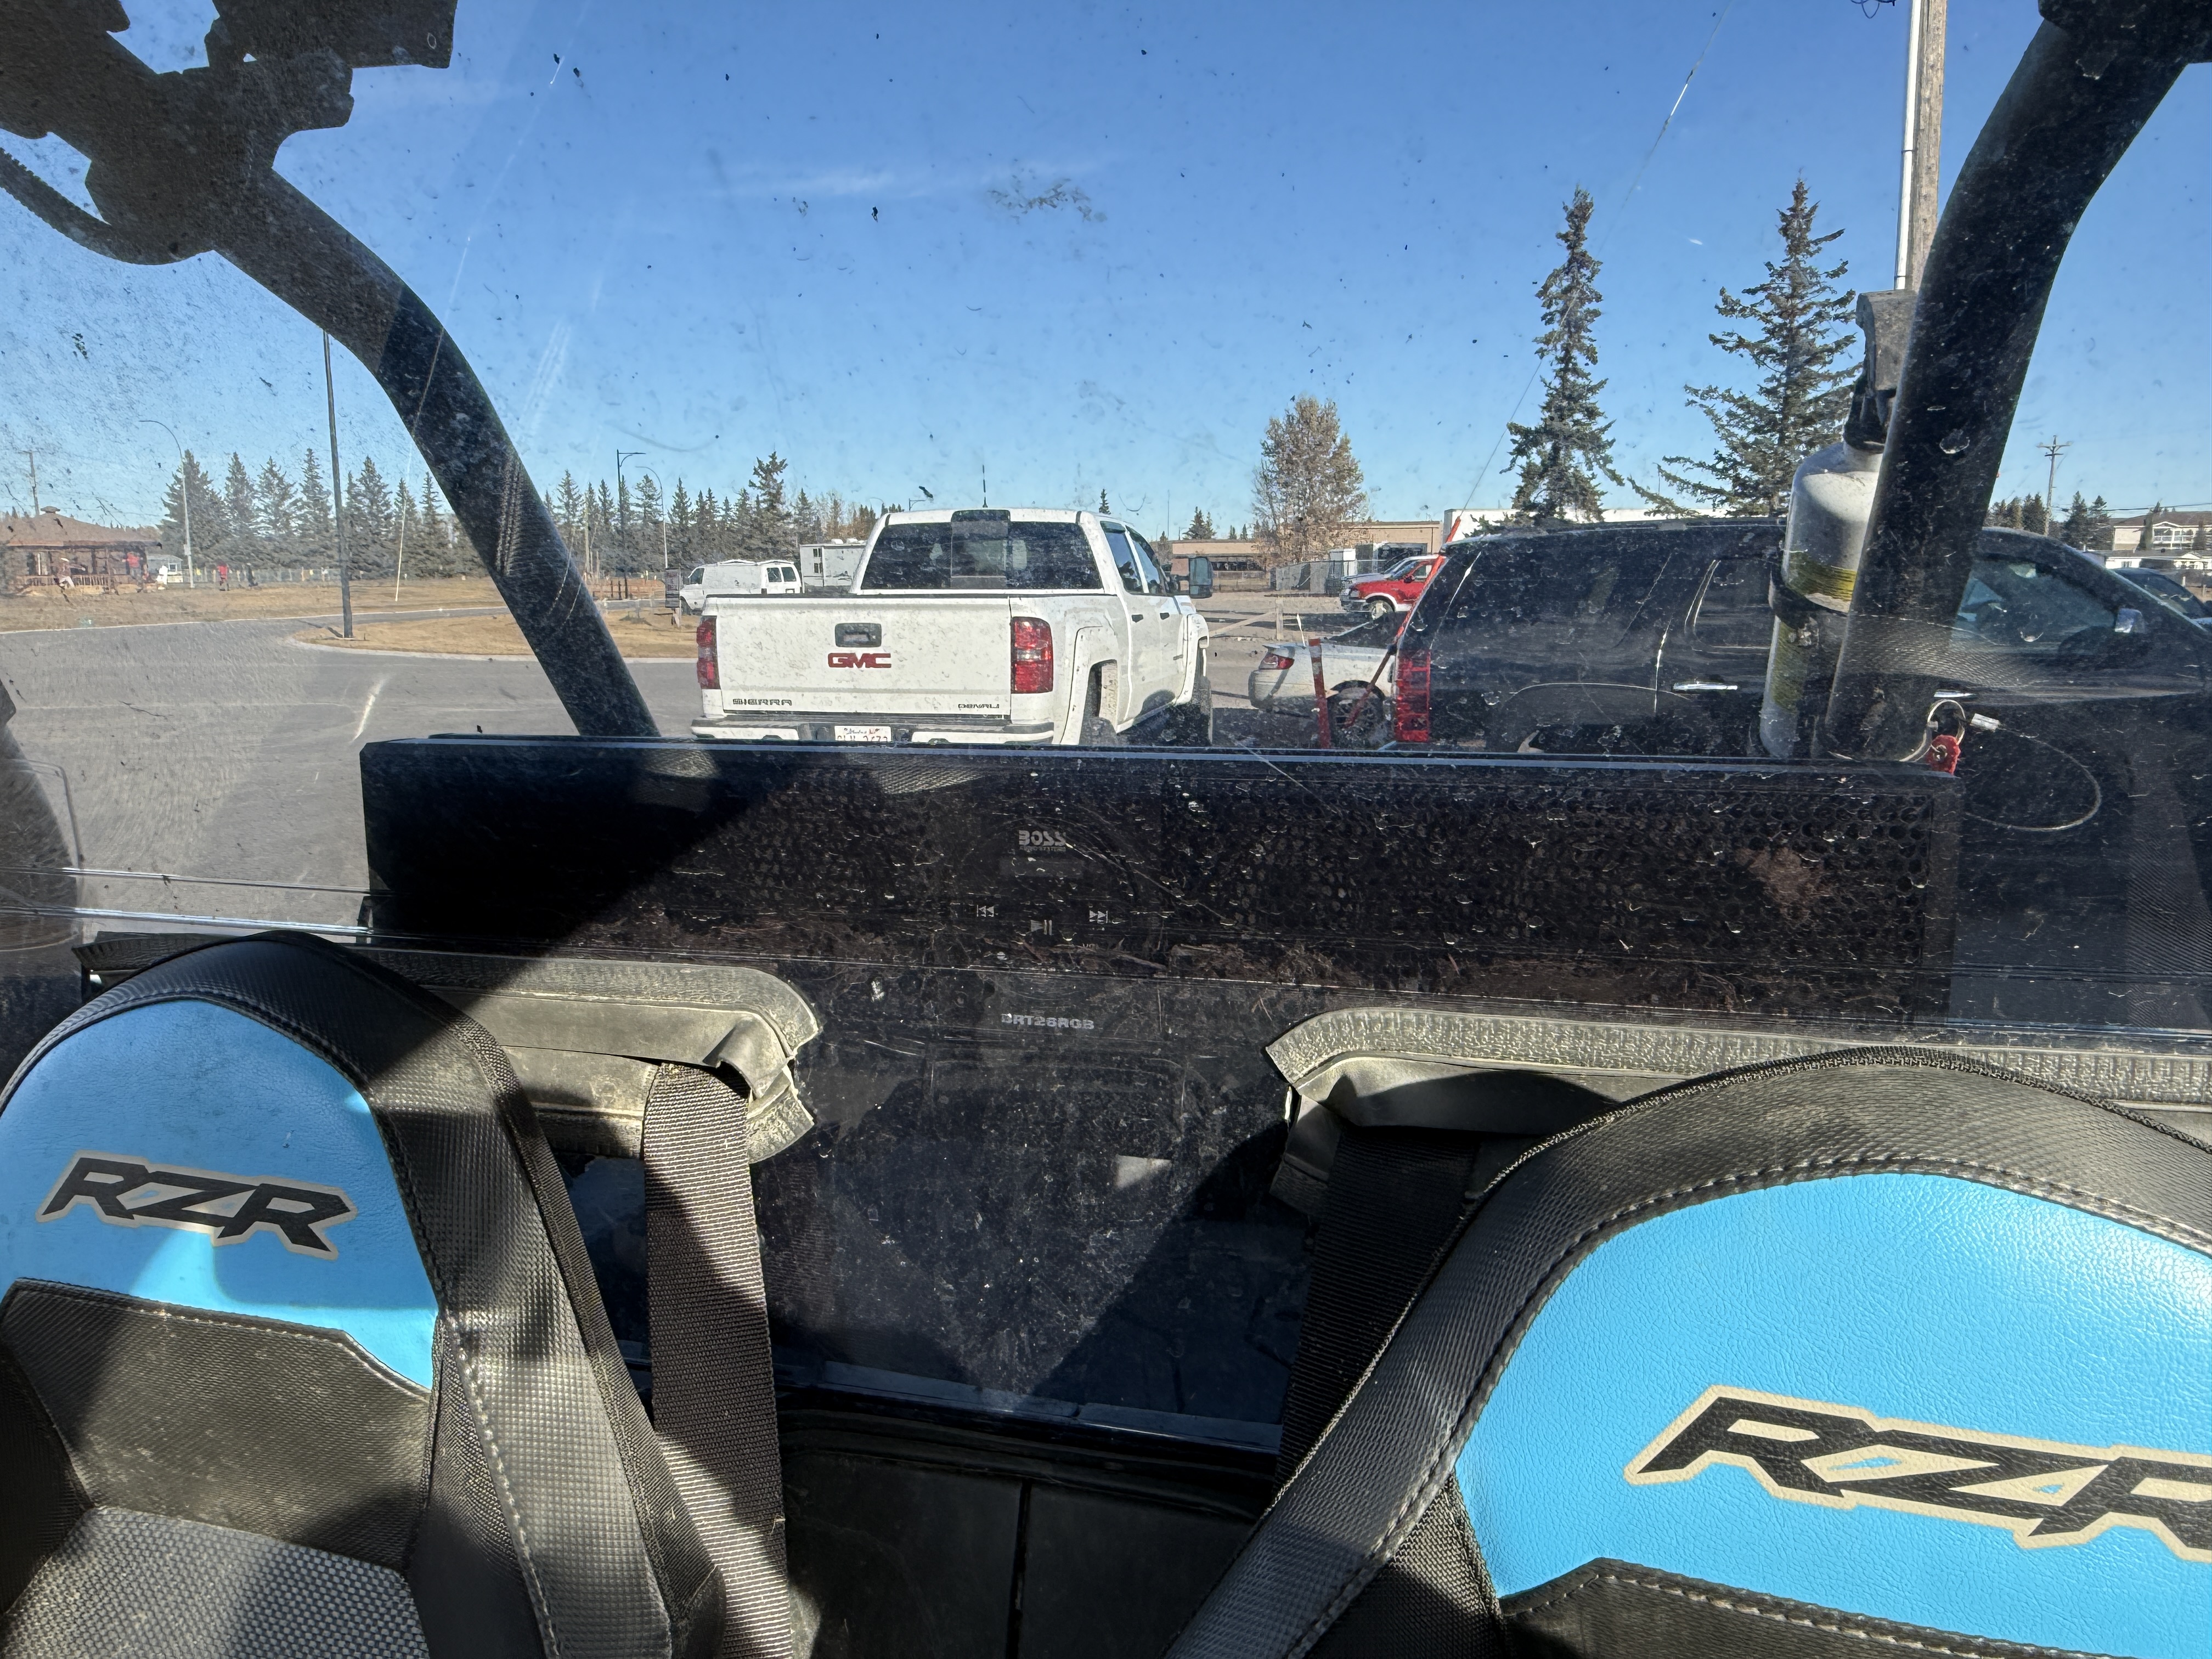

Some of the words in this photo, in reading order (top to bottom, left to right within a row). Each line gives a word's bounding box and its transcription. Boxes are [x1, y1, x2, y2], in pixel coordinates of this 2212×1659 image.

[827, 652, 891, 668] GMC
[1018, 830, 1066, 847] BOSS
[38, 1153, 354, 1256] RZR
